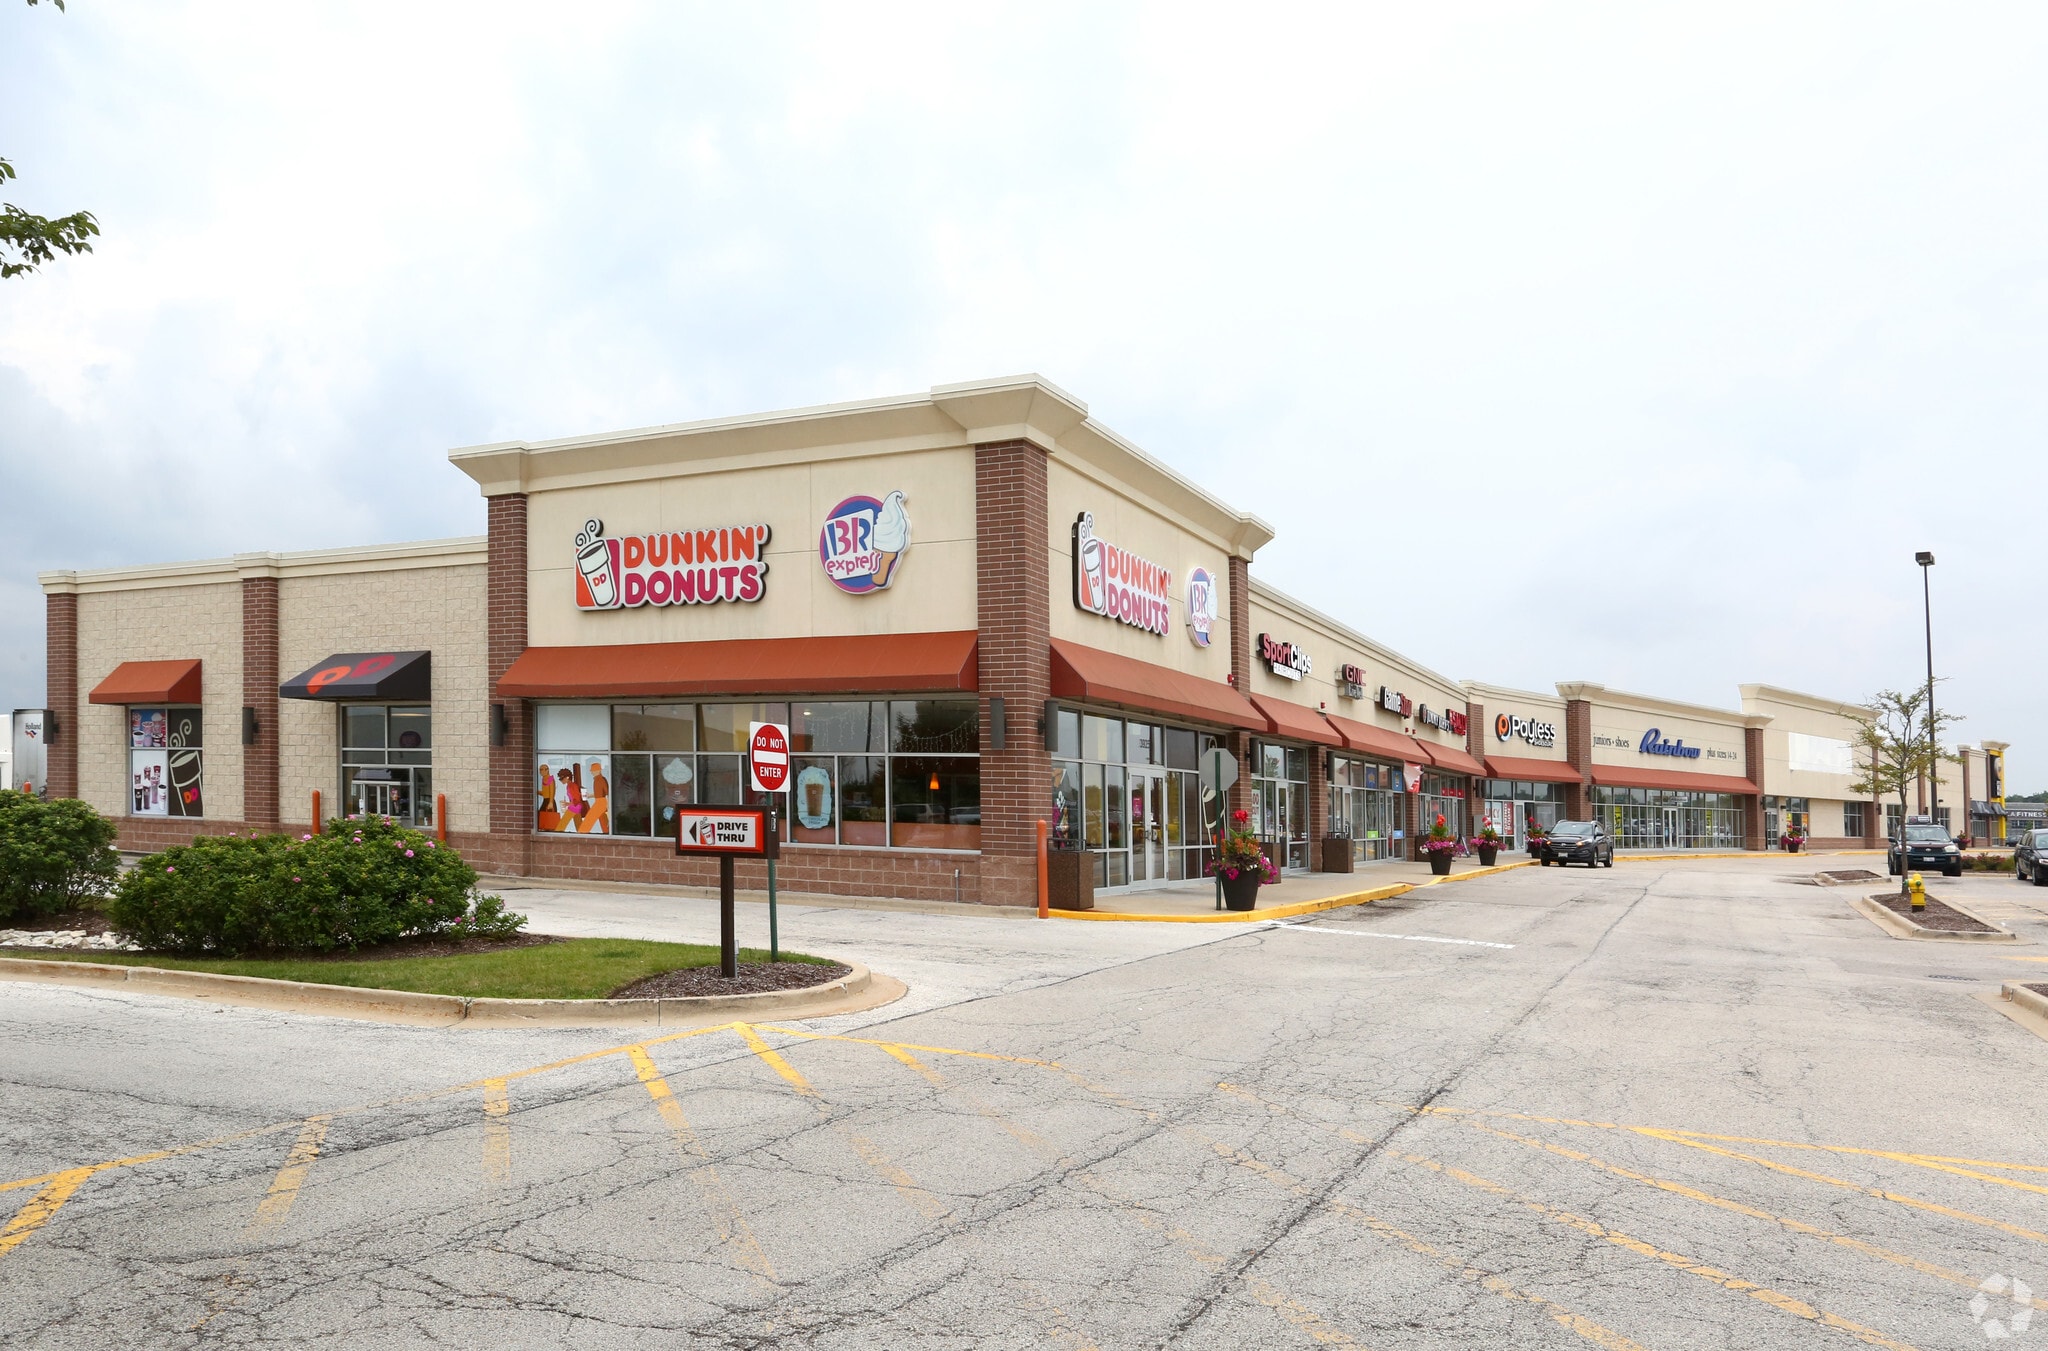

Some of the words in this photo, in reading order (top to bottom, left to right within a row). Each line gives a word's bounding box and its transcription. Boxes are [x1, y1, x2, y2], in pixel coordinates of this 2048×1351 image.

[623, 525, 764, 569] DUNKIN'
[827, 517, 871, 556] BR
[826, 550, 881, 575] express
[1108, 545, 1172, 600] DUNKIN'
[593, 573, 607, 587] DD
[624, 566, 760, 605] DONUTS
[1108, 583, 1169, 635] DONUTS
[1193, 584, 1207, 614] BR
[1346, 664, 1366, 686] GNC
[1512, 715, 1556, 743] Payless
[1593, 733, 1611, 747] juniors
[1615, 736, 1630, 748] shoes
[756, 736, 767, 747] DO
[769, 738, 783, 749] NOT
[1639, 728, 1701, 758] Rainbow
[1706, 747, 1716, 759] plus
[1716, 748, 1727, 759] sizes
[760, 767, 781, 778] ENTER
[184, 788, 199, 804] DD
[717, 822, 748, 831] DRIVE
[717, 833, 745, 842] THRU
